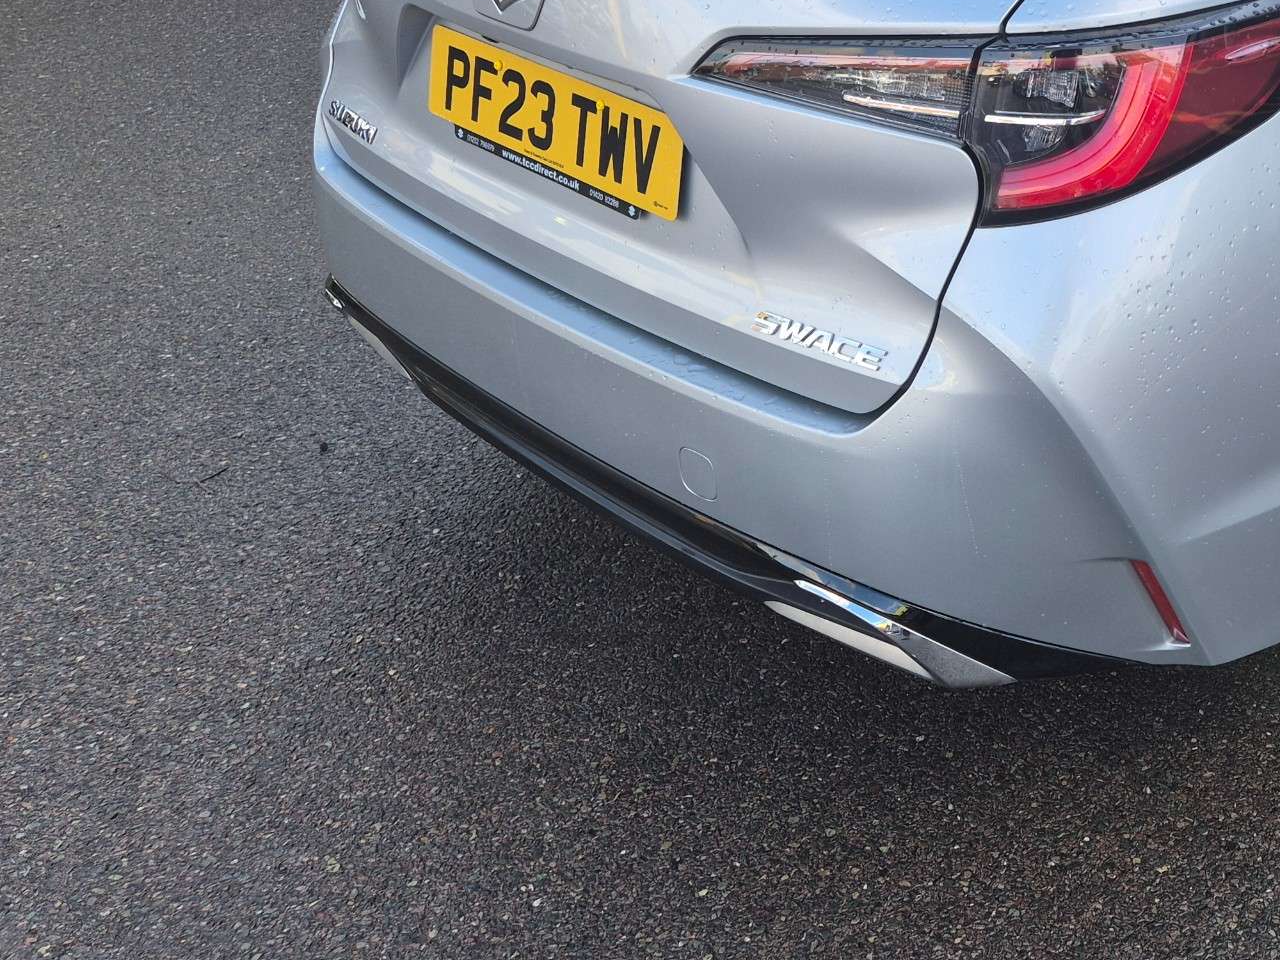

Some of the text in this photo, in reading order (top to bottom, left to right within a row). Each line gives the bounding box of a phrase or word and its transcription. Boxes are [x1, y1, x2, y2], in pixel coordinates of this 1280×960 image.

[328, 100, 378, 145] SUZUKI
[445, 45, 661, 195] PF23 TWV
[502, 149, 580, 191] www.tccdirect.co.uk
[751, 308, 888, 371] SWACE
